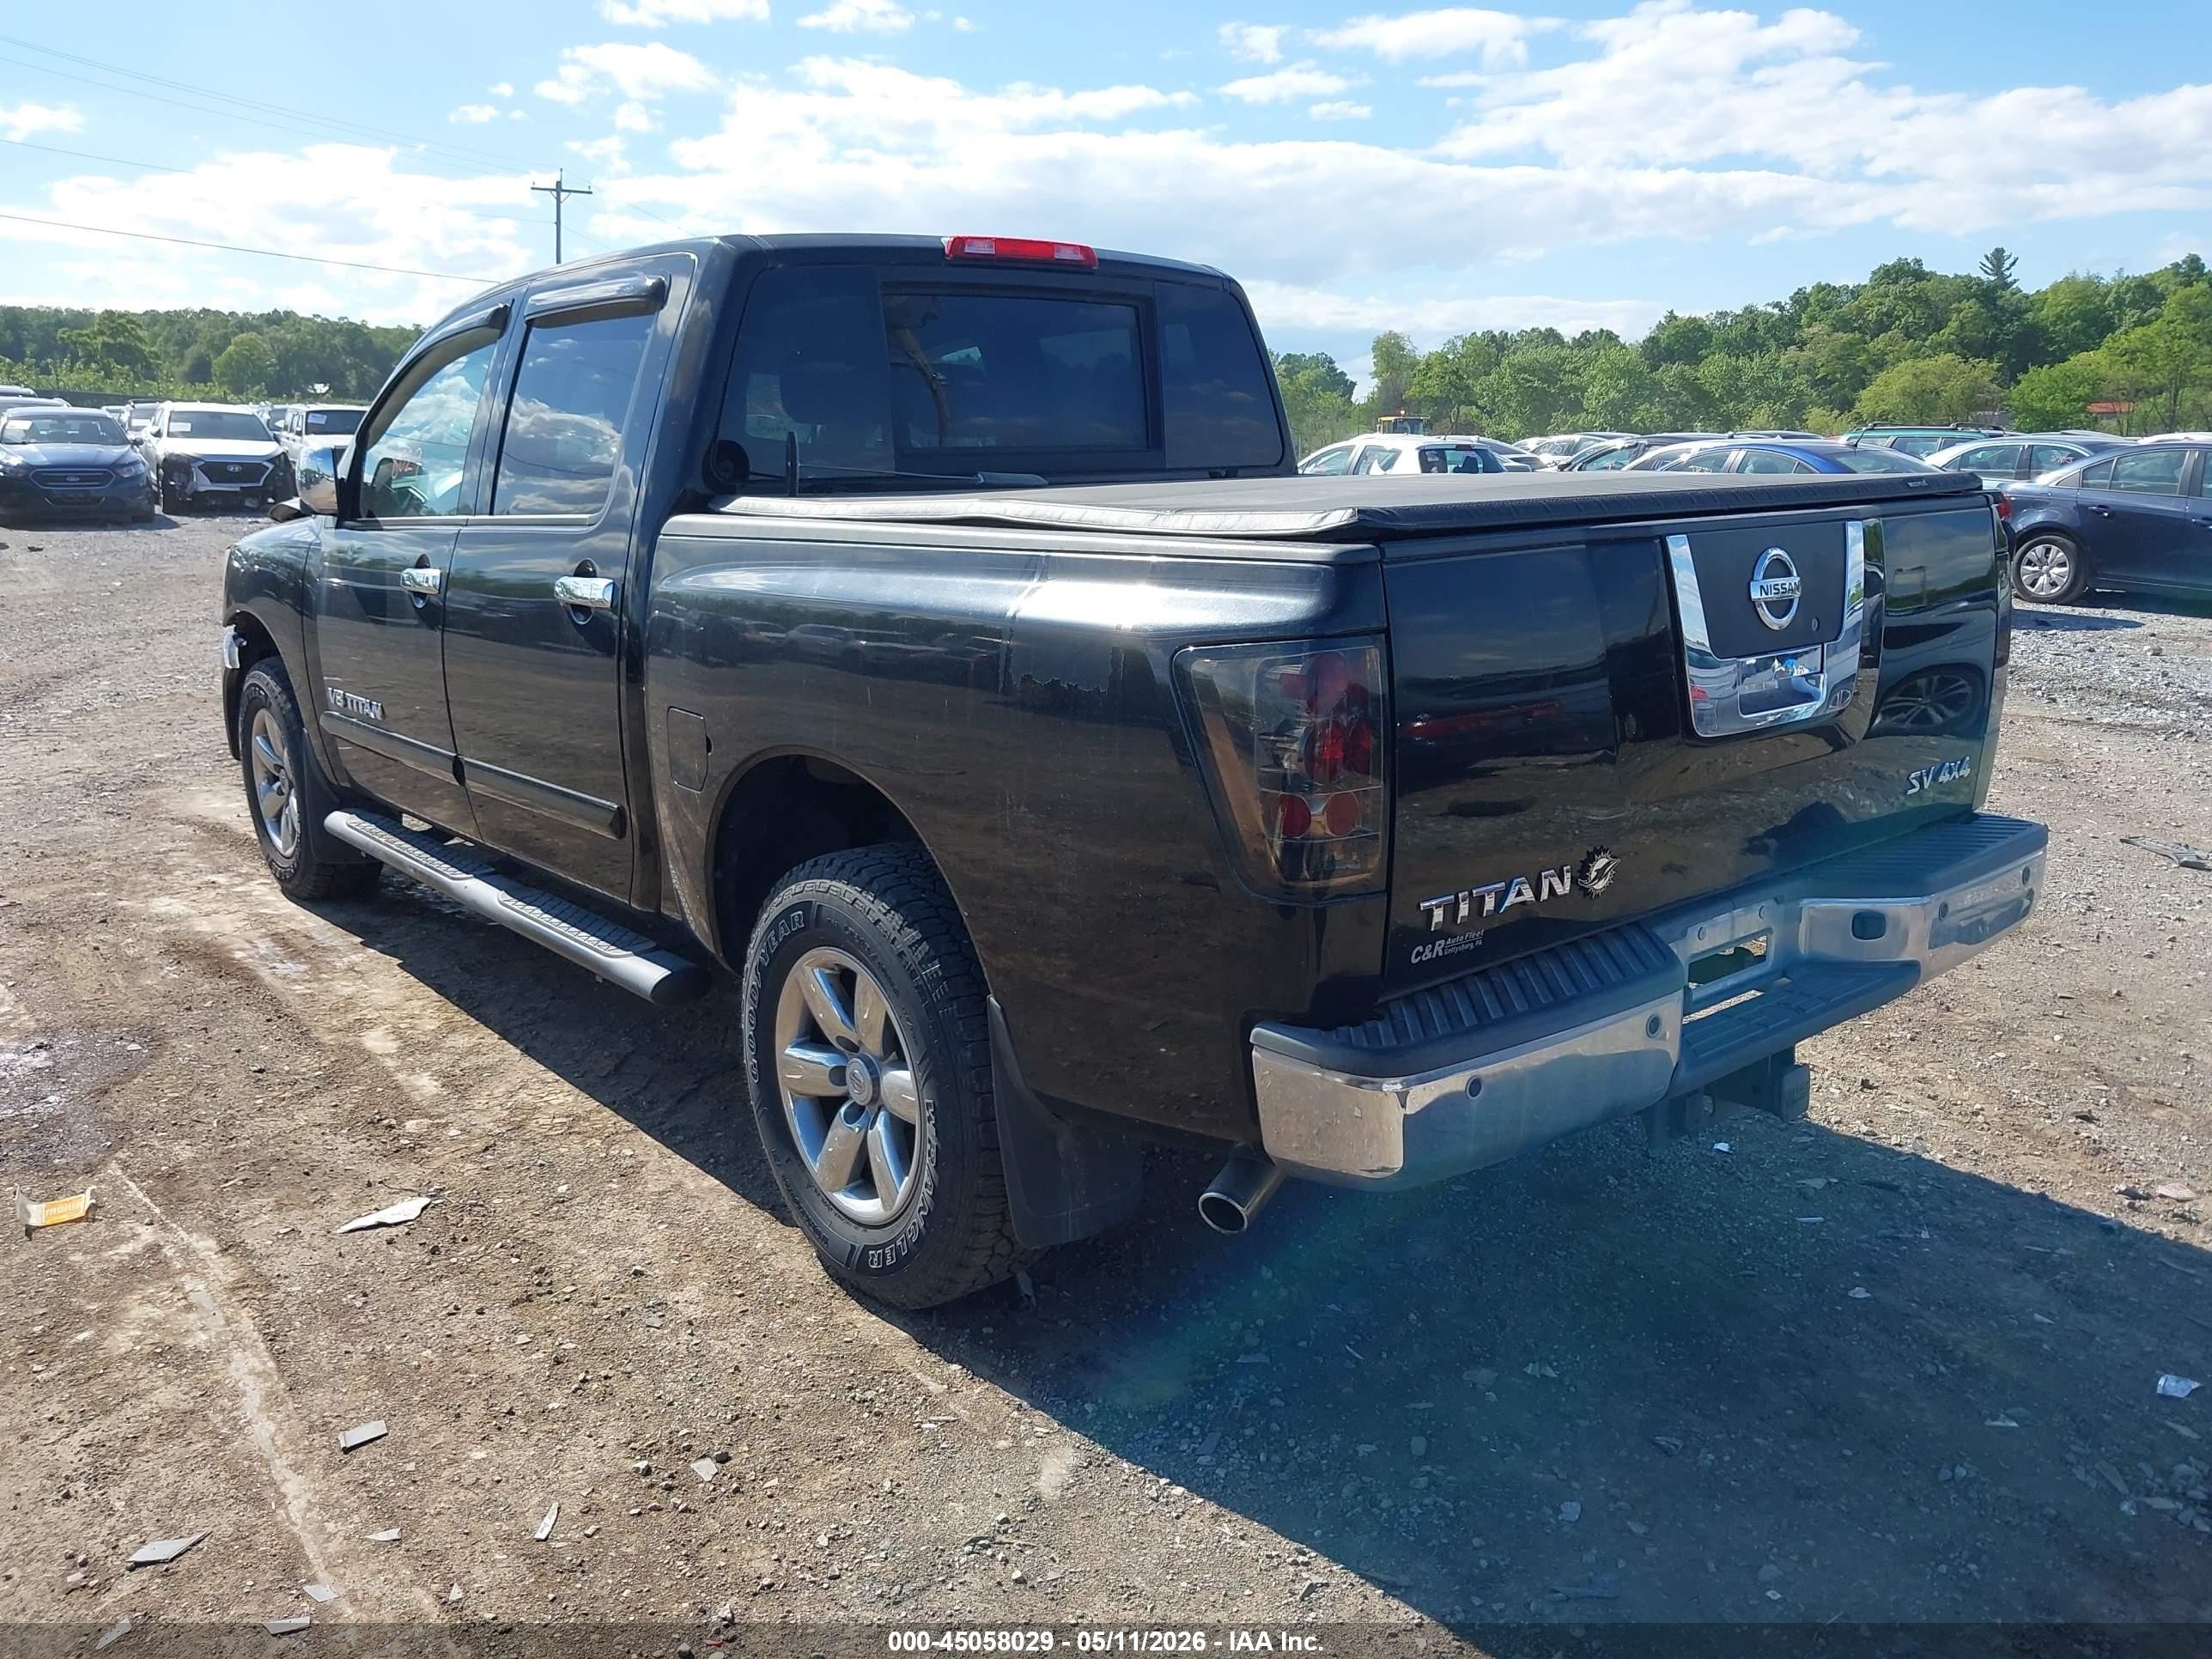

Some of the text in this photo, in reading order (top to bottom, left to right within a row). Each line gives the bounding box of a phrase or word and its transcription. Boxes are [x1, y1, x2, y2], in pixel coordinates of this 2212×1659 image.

[1759, 581, 1800, 597] NISSAN
[345, 692, 382, 720] TITAN
[1906, 766, 1936, 795] SV
[1419, 865, 1571, 932] TITAN
[1411, 939, 1445, 963] C&R
[1446, 935, 1464, 945] Auto
[748, 910, 805, 1083] GOODYEAR
[868, 1099, 939, 1268] WRANGLER
